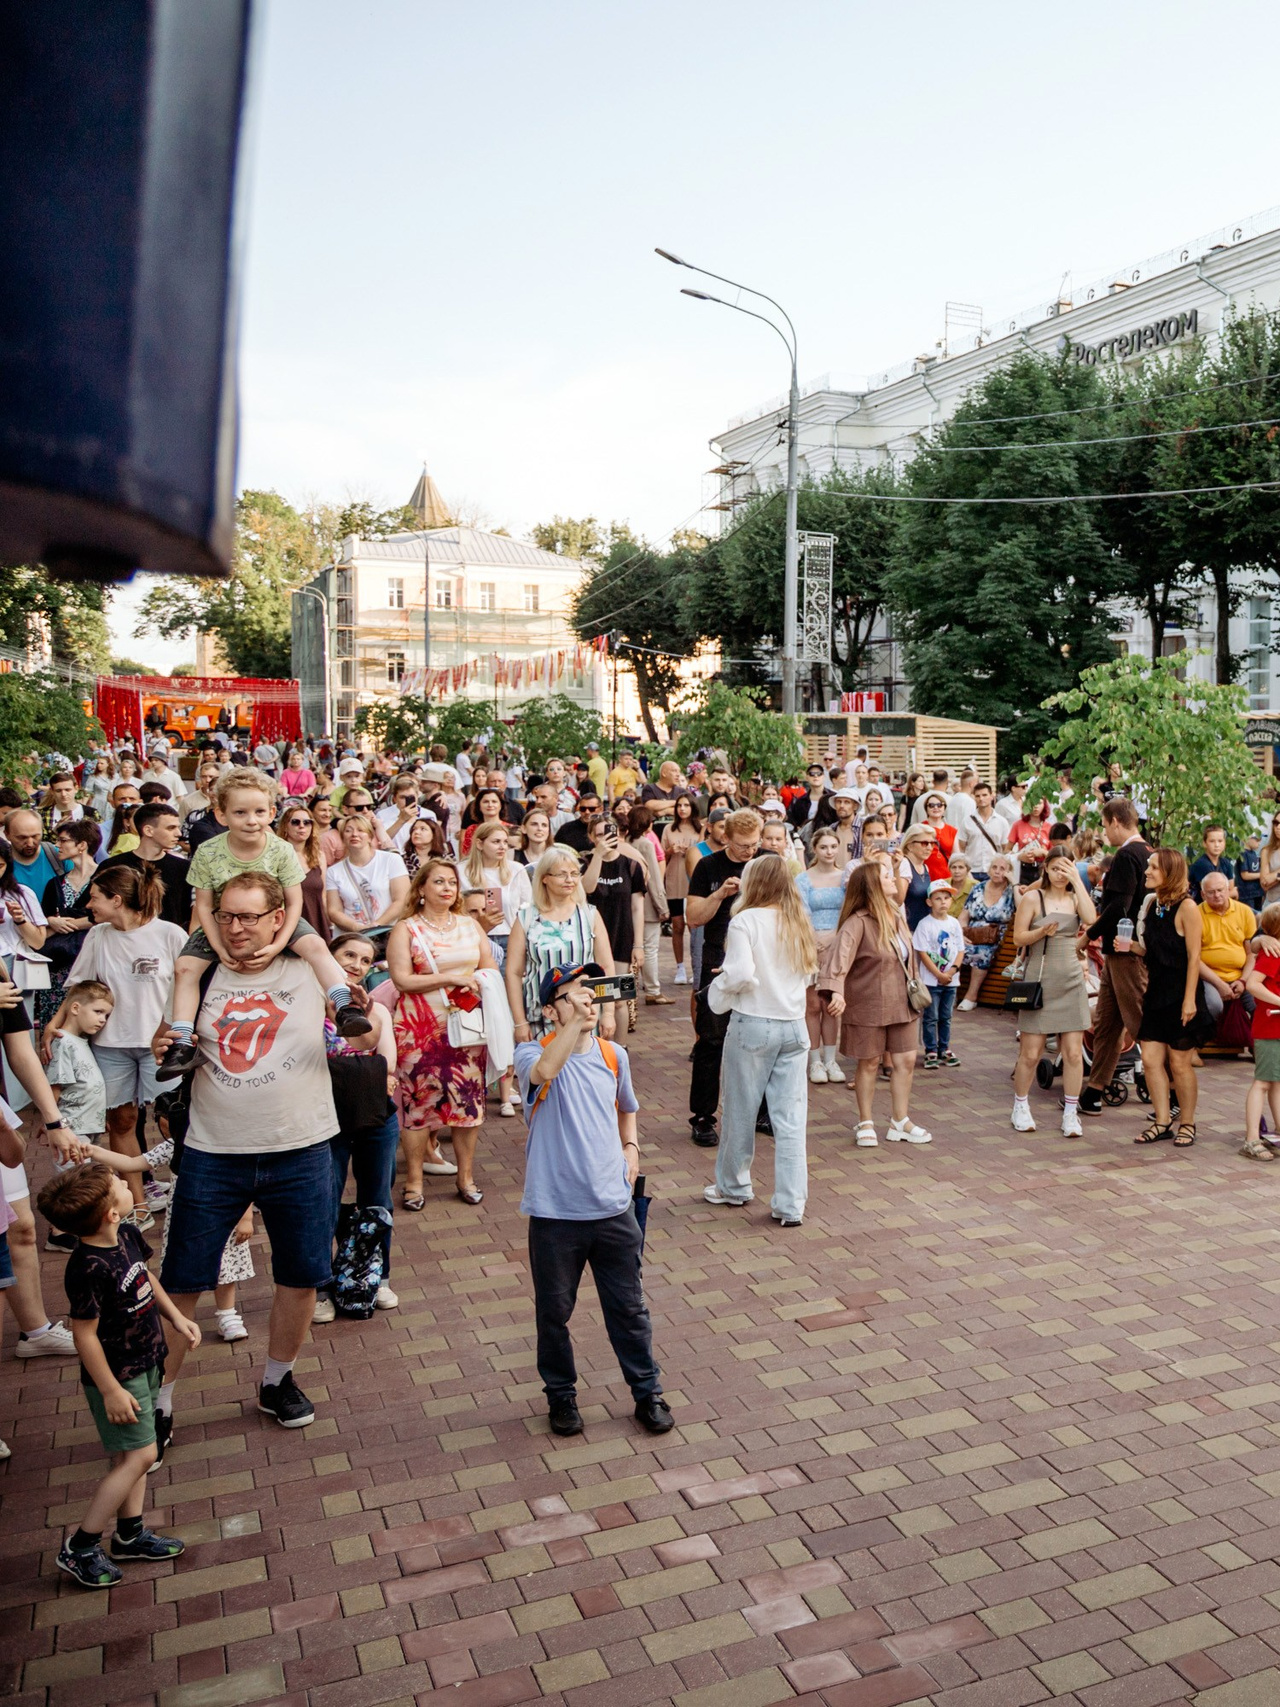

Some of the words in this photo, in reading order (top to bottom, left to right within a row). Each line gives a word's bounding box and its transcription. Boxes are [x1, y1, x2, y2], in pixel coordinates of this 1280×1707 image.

[1074, 308, 1198, 365] Ростелеком
[212, 1064, 241, 1089] WORLD
[246, 1071, 276, 1088] TOUR
